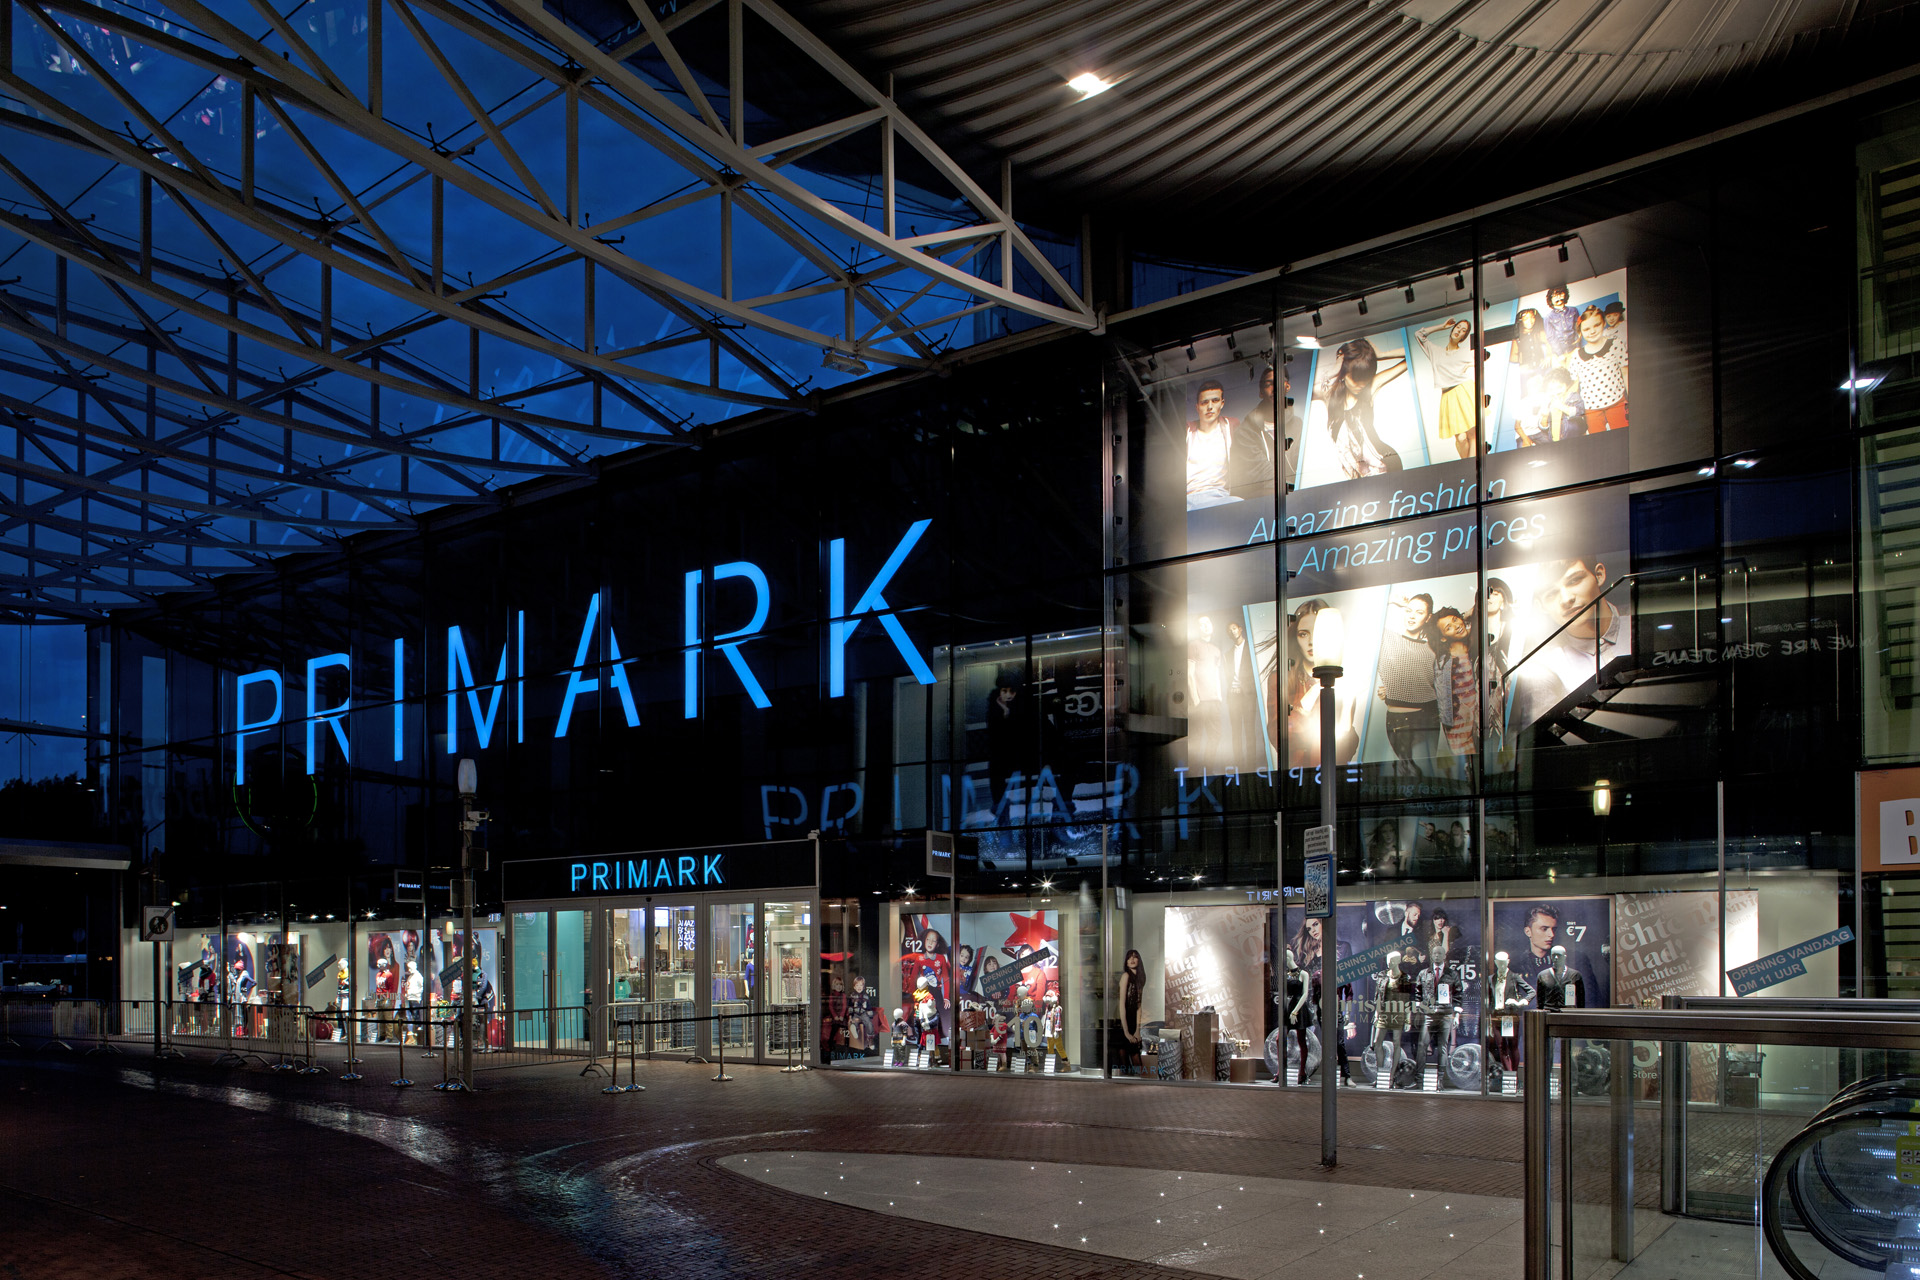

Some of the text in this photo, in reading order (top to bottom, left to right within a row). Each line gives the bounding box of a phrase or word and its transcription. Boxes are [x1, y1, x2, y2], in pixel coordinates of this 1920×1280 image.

[1247, 499, 1380, 545] Amazing
[1297, 512, 1547, 576] Amazing prces
[236, 518, 938, 786] PRIMARK
[571, 853, 727, 892] PRIMARK
[905, 940, 923, 953] €12
[1367, 936, 1414, 959] VANDAAG
[1566, 925, 1587, 943] €7
[981, 949, 1048, 984] OPENING VANDAAG
[1346, 971, 1356, 980] 11
[1357, 962, 1378, 976] UUR
[1731, 929, 1850, 982] OPENING VANDAAG
[985, 973, 1021, 995] OM 11 UUR
[1737, 963, 1802, 994] OM 11 UUR
[994, 1015, 1044, 1048] €10
